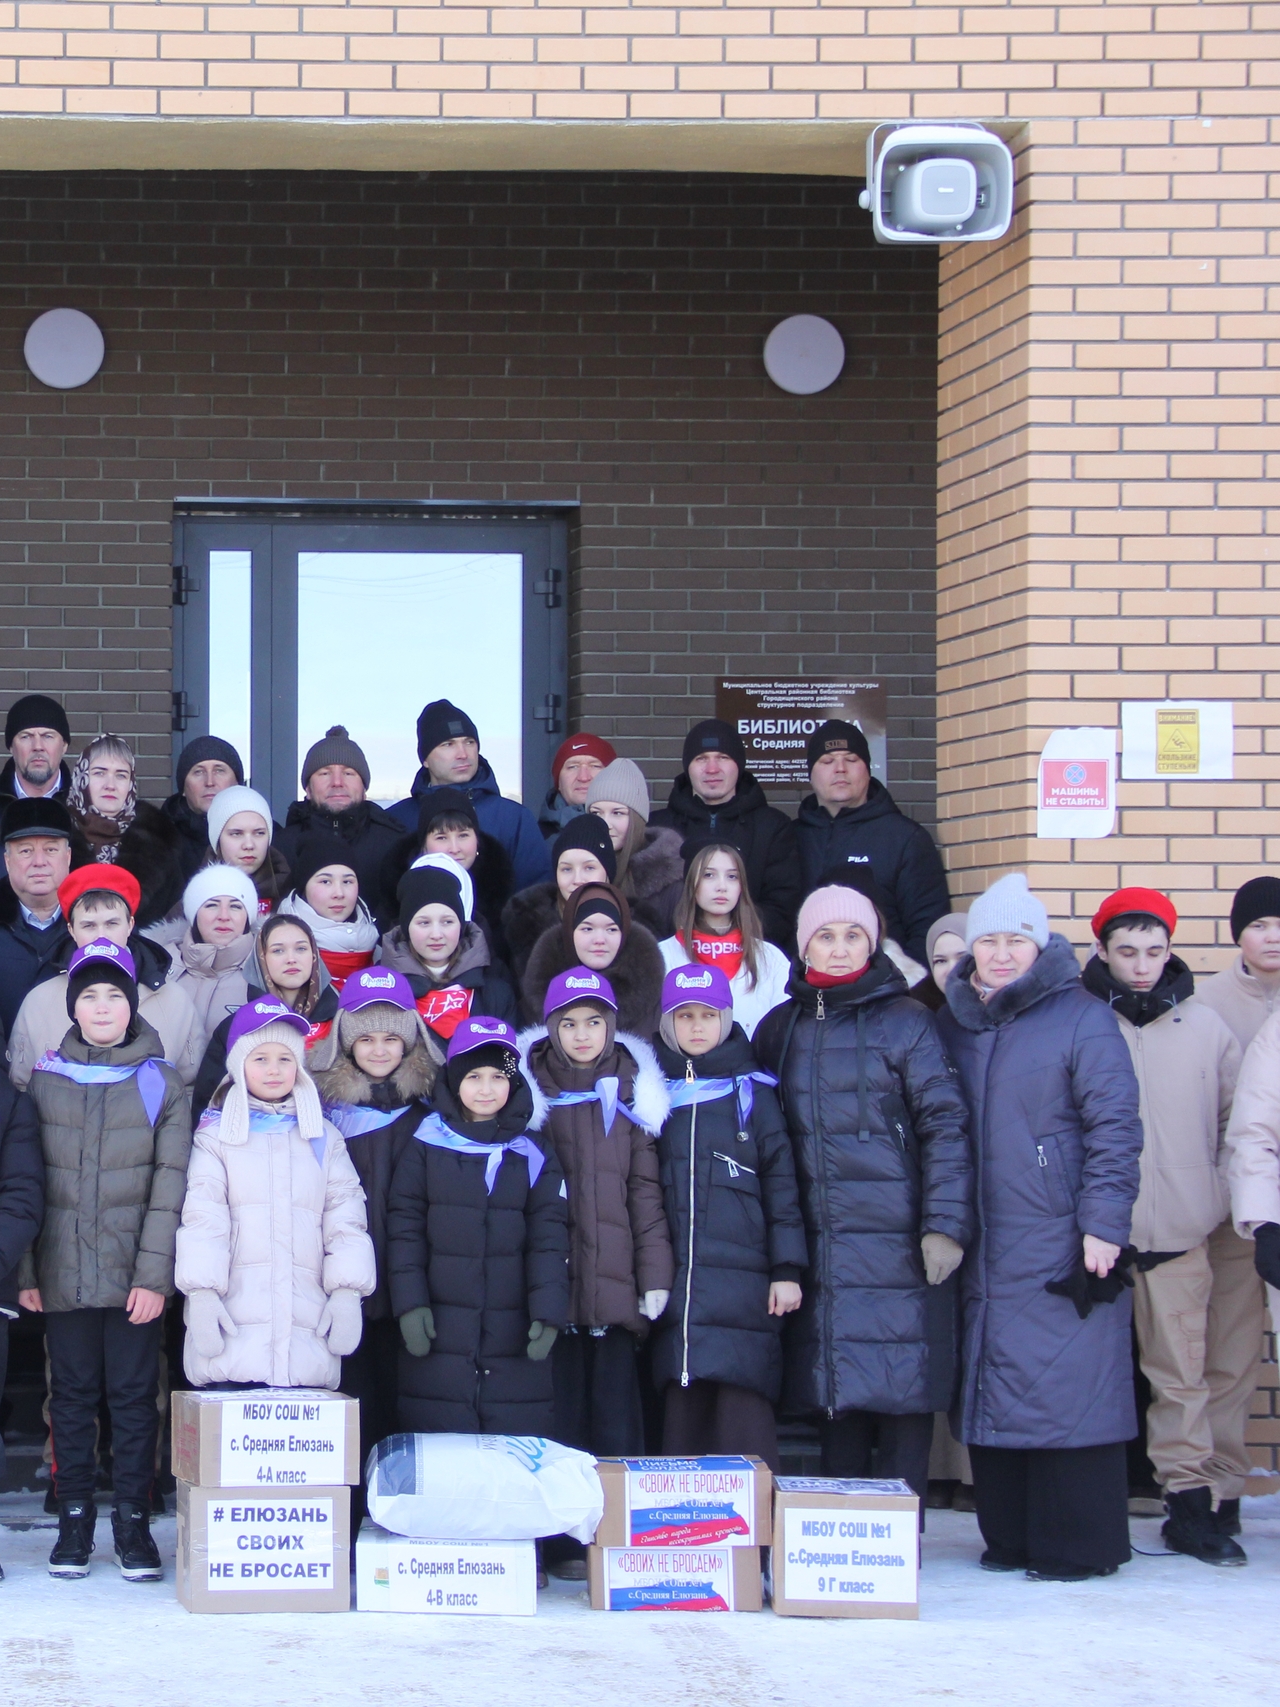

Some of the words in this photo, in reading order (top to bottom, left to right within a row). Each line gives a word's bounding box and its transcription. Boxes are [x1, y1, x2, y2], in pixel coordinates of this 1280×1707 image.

[752, 738, 806, 751] Средняя
[1051, 787, 1099, 796] МАШИНЫ
[1045, 797, 1058, 806] НЕ
[1059, 798, 1104, 806] СТАВИТЬ!
[847, 855, 869, 863] FILA
[243, 1403, 273, 1420] МБОУ
[275, 1404, 300, 1420] СОШ
[302, 1404, 321, 1421] №1
[230, 1438, 239, 1451] с.
[242, 1434, 286, 1455] Средняя
[288, 1435, 335, 1452] Елюзань
[256, 1466, 273, 1483] 4-А
[276, 1470, 307, 1484] класс
[639, 1473, 676, 1493] «СВОИХ
[679, 1474, 691, 1493] НЕ
[694, 1474, 745, 1494] БРОСАЕМ»
[213, 1507, 224, 1522] #
[230, 1507, 328, 1522] ЕЛЮЗАНЬ
[649, 1510, 691, 1522] с.Средняя
[693, 1511, 729, 1520] Елюзань
[801, 1520, 836, 1537] МБОУ
[839, 1521, 868, 1538] СОШ
[871, 1522, 892, 1539] №1
[237, 1535, 304, 1550] СВОИХ
[618, 1553, 655, 1572] «СВОИХ
[658, 1553, 669, 1572] НЕ
[673, 1553, 723, 1573] БРОСАЕМ»
[788, 1548, 848, 1568] с.Средняя
[851, 1550, 905, 1567] Елюзань
[209, 1563, 234, 1578] НЕ
[240, 1563, 331, 1578] БРОСАЕТ
[397, 1561, 407, 1575] с.
[410, 1557, 454, 1578] Средняя
[457, 1558, 506, 1575] Елюзань
[818, 1576, 826, 1592] 9
[829, 1577, 837, 1592] Г
[839, 1581, 875, 1593] класс
[426, 1589, 443, 1606] 4-В
[446, 1593, 478, 1606] класс
[628, 1590, 670, 1601] с.Средняя
[672, 1591, 709, 1600] Елюзань
